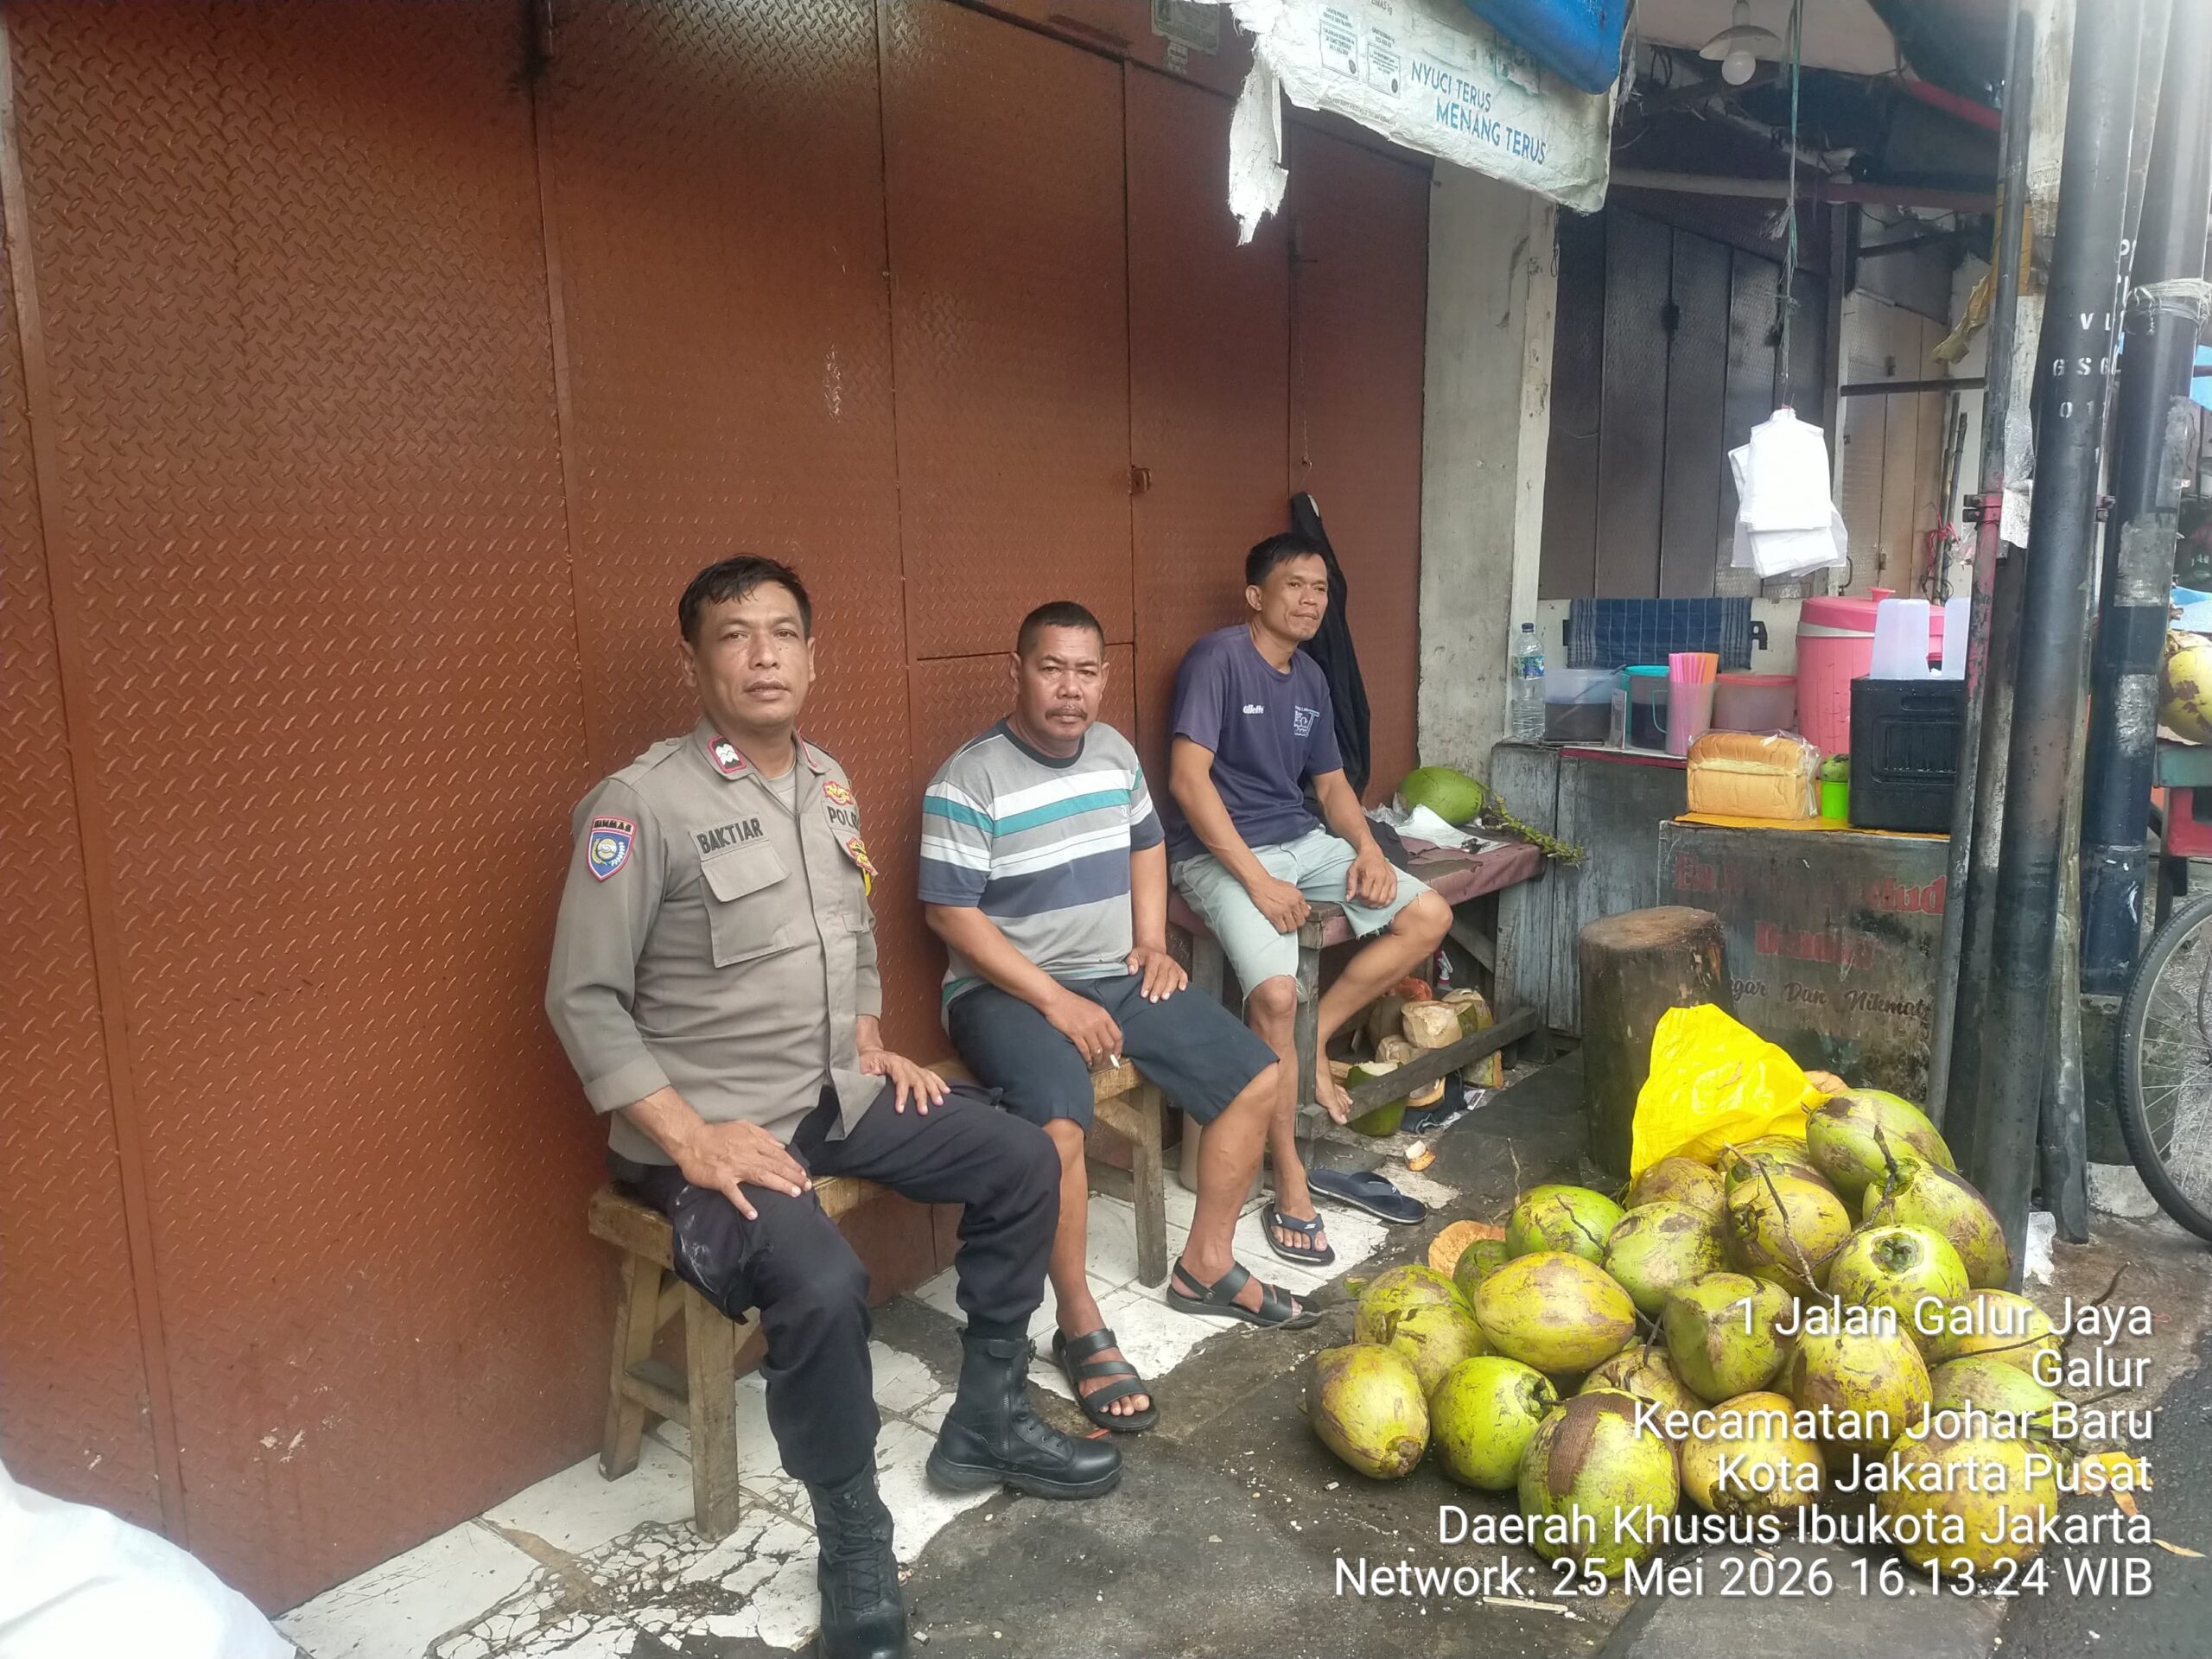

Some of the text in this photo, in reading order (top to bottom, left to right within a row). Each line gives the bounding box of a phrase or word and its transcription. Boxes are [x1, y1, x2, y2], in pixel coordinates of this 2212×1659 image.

[1411, 60, 1452, 95] NYUCI
[1456, 79, 1491, 113] TERUS
[1436, 96, 1501, 147] MENANG
[1505, 126, 1547, 166] TERUS
[696, 817, 764, 855] BAKTIAR
